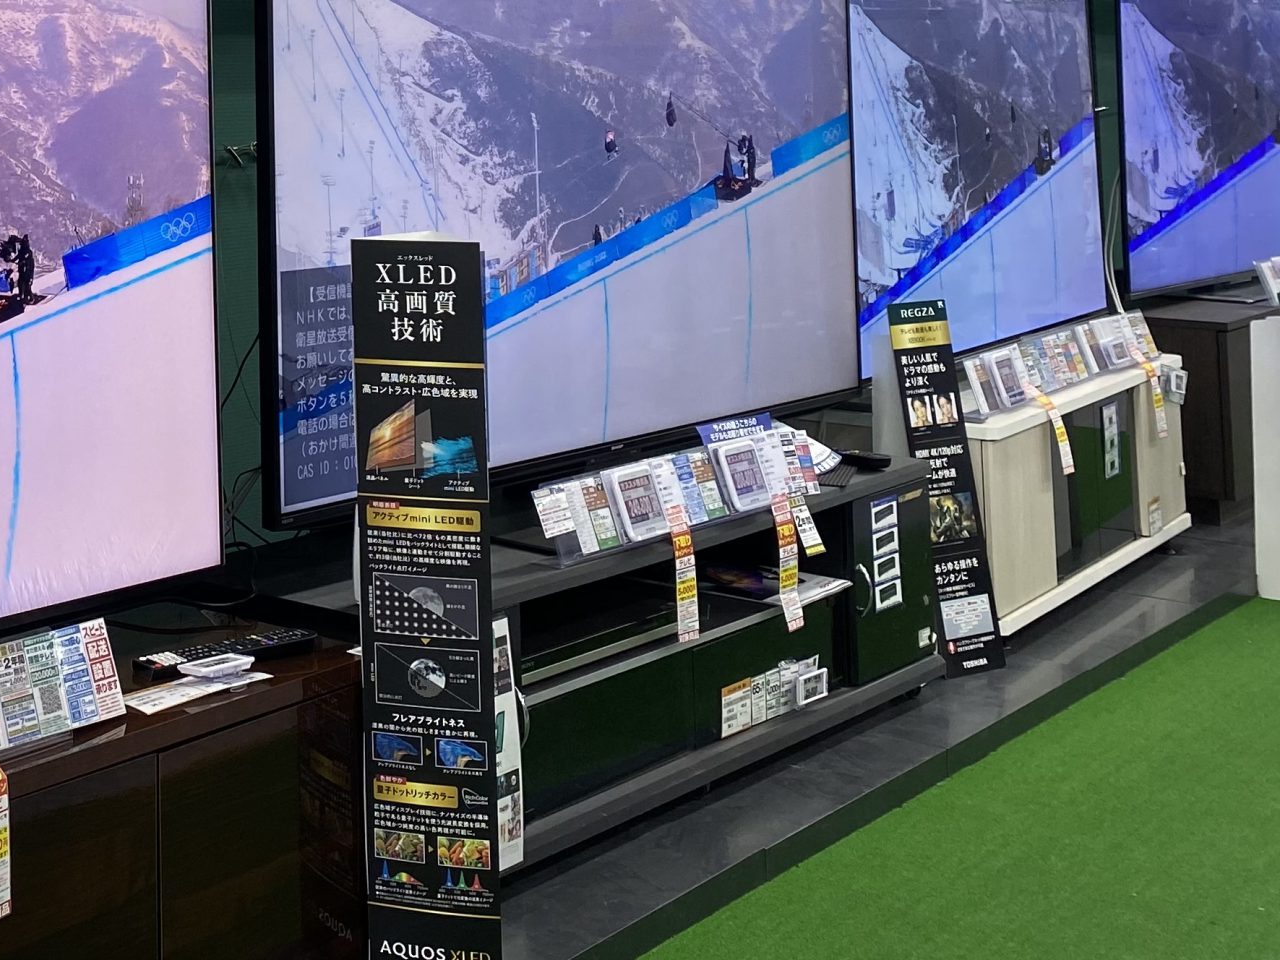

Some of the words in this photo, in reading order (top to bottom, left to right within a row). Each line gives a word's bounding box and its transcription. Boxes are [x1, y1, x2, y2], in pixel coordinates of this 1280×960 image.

[397, 254, 433, 262] エックスレッド
[375, 263, 457, 285] XLED
[377, 289, 457, 316] 高画質
[297, 306, 351, 325] NHKでは、
[901, 307, 935, 319] REGZA
[391, 318, 444, 343] 技術
[901, 353, 938, 365] 美しい人肌で
[903, 363, 946, 376] ドラマの感動も
[381, 373, 457, 386] 驚異的な高輝度と、
[905, 376, 929, 387] より深く
[362, 383, 478, 400] 高コントラスト・広色域を実現
[297, 463, 314, 480] CAS
[320, 461, 329, 474] ID
[372, 512, 431, 524] アクティブmini
[435, 514, 475, 526] LED駆動
[796, 515, 814, 528] 2年間
[782, 546, 796, 556] テレビ
[678, 559, 693, 568] テレビ
[934, 558, 979, 574] あらゆる操作を
[936, 571, 969, 585] カンタンに
[82, 621, 105, 638] スピード
[87, 640, 109, 660] 配送
[3, 654, 25, 670] 2年間
[92, 660, 115, 680] 設置
[962, 658, 988, 669] TOSHIBA
[95, 680, 118, 696] 承ります
[392, 713, 465, 728] フレアブライトネス
[377, 784, 455, 801] 量子ドットリッチカラー
[380, 940, 446, 960] AQUOS
